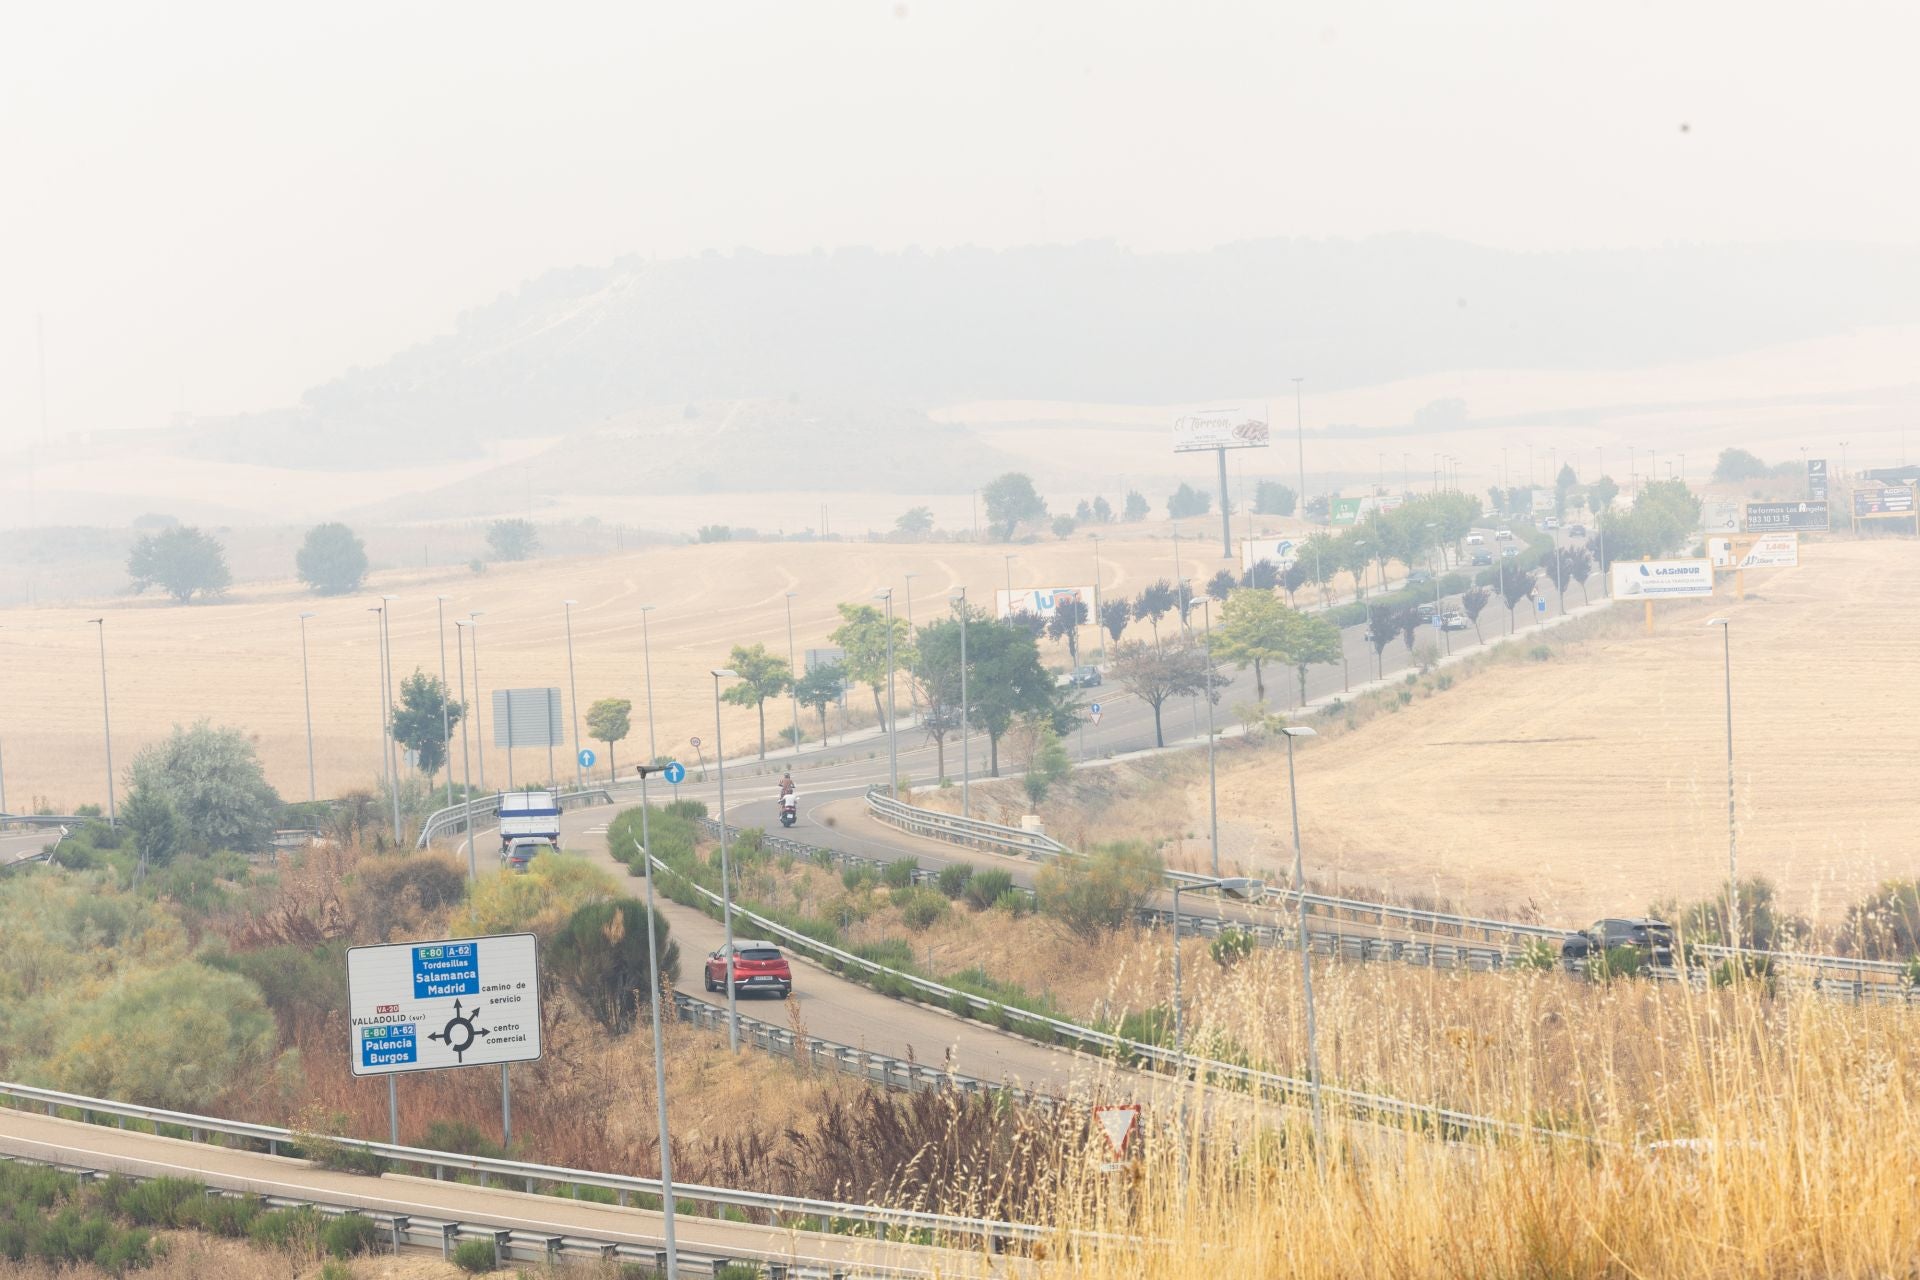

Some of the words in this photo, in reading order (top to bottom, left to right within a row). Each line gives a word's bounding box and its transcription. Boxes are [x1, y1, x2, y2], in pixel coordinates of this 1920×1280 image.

[1748, 506, 1784, 514] Reformas
[420, 948, 442, 959] E-80
[448, 946, 470, 956] A-62
[423, 960, 469, 970] Tordesillas
[416, 971, 476, 983] Salamanca
[428, 983, 466, 995] Madrid
[482, 983, 511, 992] camino
[516, 982, 526, 990] de
[490, 995, 522, 1004] servicio
[352, 1015, 406, 1026] VALLADOLID
[364, 1028, 386, 1038] E-80
[392, 1026, 414, 1036] A-62
[493, 1024, 520, 1032] centro
[366, 1039, 412, 1051] Palencia
[486, 1034, 526, 1045] comercial
[370, 1052, 409, 1064] Burgos
